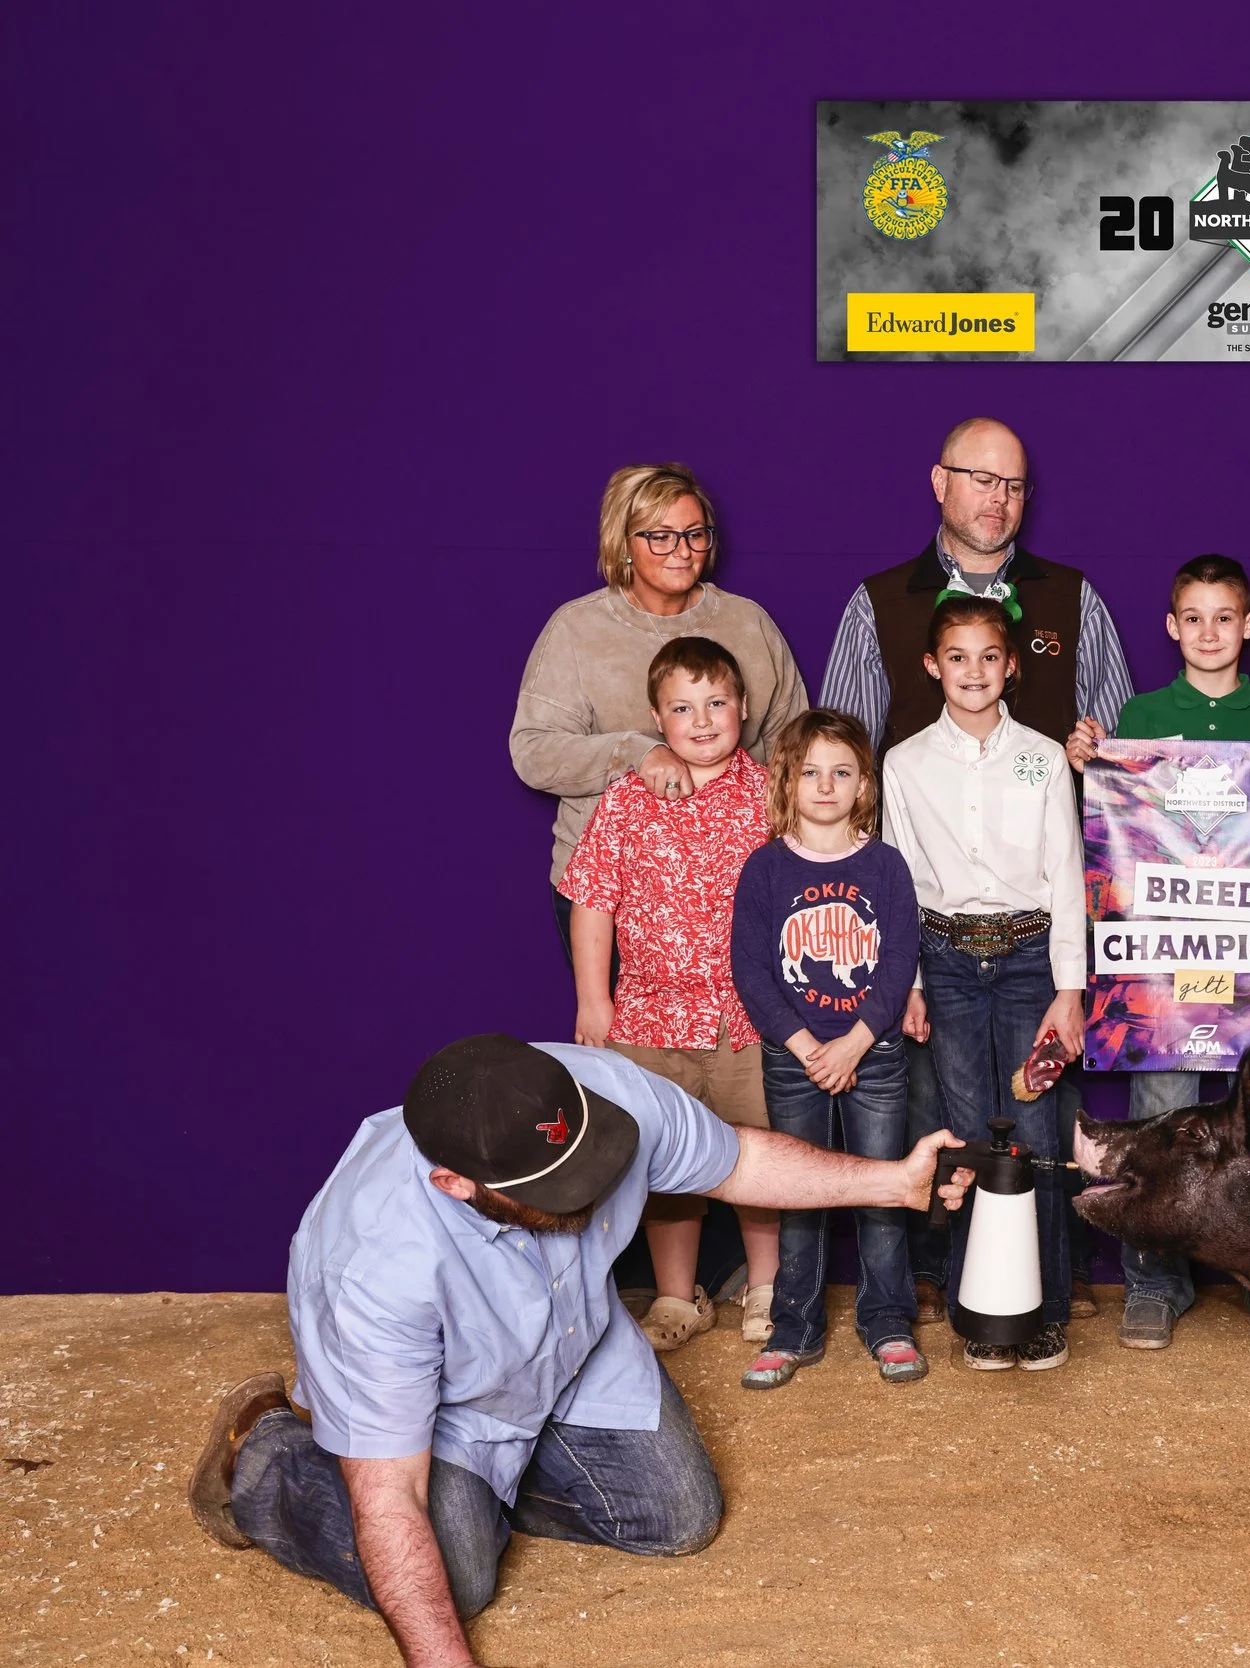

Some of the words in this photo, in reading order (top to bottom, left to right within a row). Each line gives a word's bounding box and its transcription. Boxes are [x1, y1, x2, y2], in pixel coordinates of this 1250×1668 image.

[876, 167, 935, 192] AGRICULTURAL
[890, 178, 922, 190] FFA
[881, 211, 930, 228] EDUCATION
[1100, 196, 1174, 251] 20
[866, 312, 947, 332] Edward
[1034, 630, 1044, 638] THE
[1166, 799, 1210, 807] NORTHWEST
[803, 882, 860, 902] OKIE
[1178, 974, 1231, 1001] gilt
[805, 988, 867, 1012] SPIRIT
[1182, 1040, 1221, 1054] ADM
